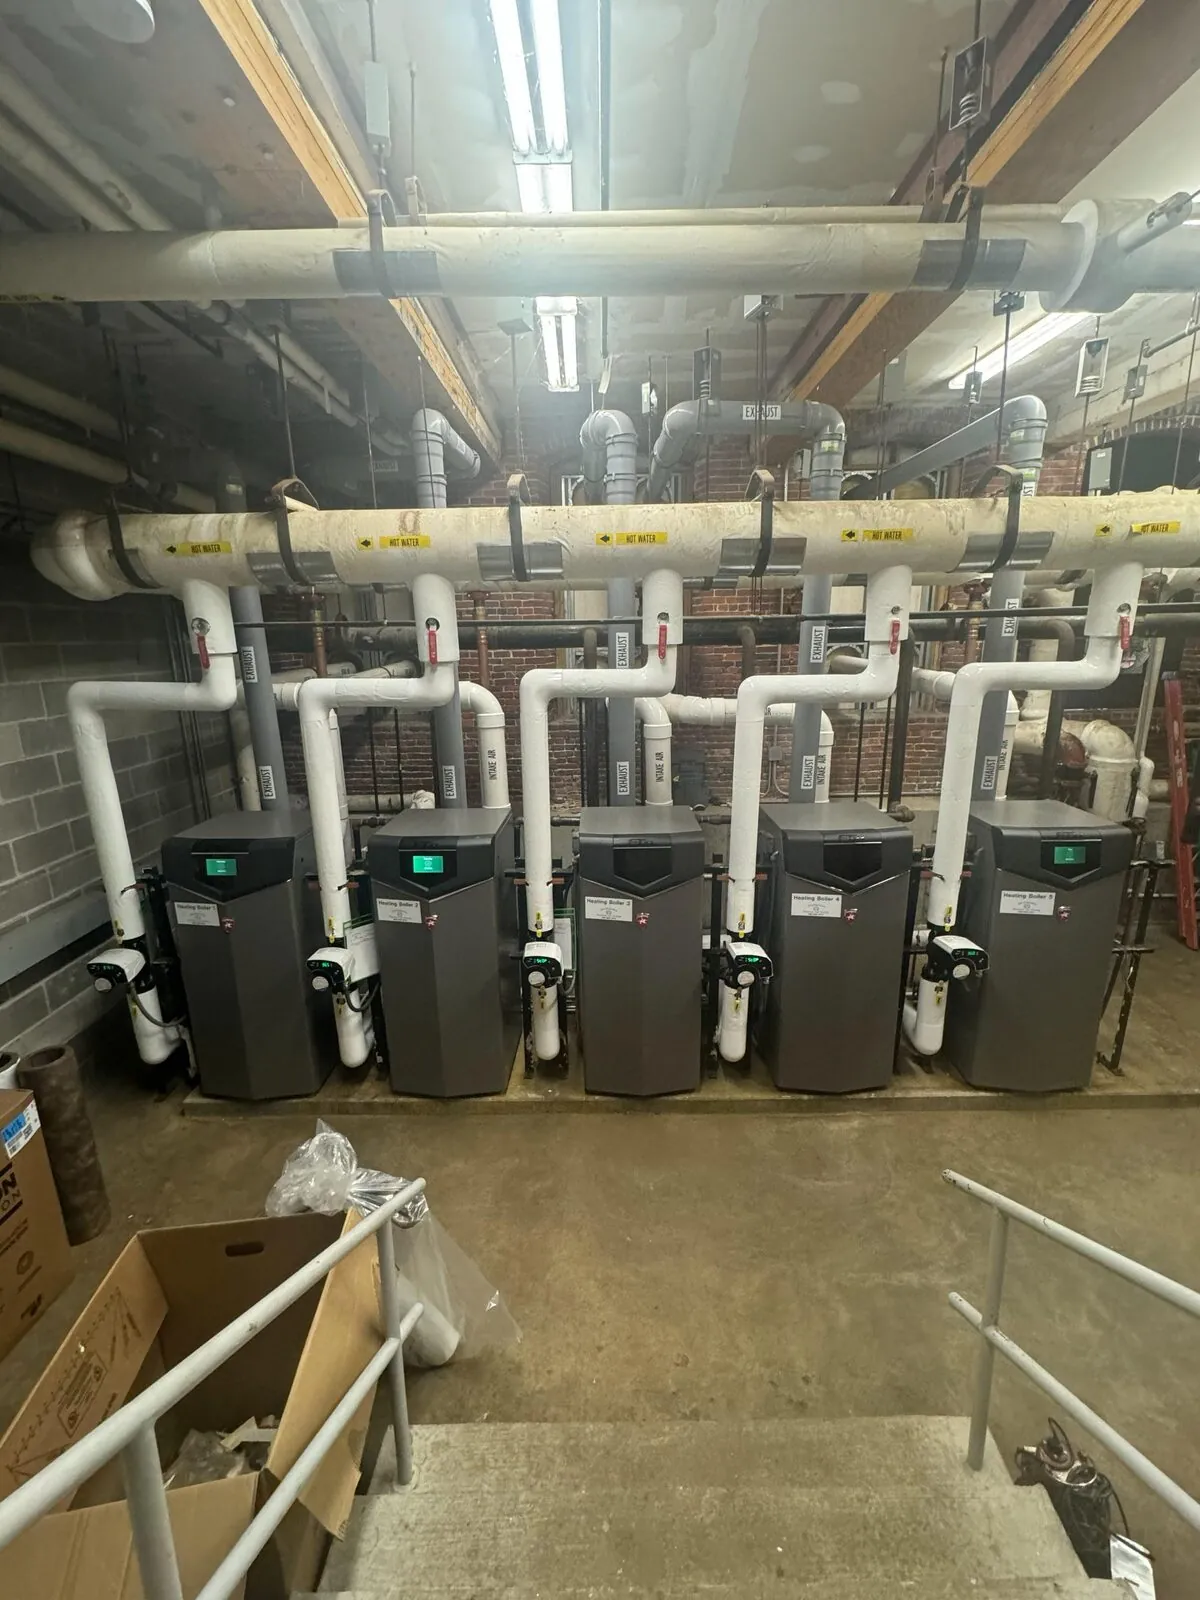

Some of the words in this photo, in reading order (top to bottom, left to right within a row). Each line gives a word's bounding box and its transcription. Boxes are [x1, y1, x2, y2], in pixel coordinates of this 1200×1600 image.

[871, 531, 882, 541] HOT
[883, 531, 903, 541] WATER
[1150, 523, 1169, 533] WATER
[191, 545, 202, 554] HOT
[203, 544, 221, 553] WATER
[389, 538, 400, 547] HOT
[401, 538, 420, 547] WATER
[626, 535, 636, 544] HOT
[638, 534, 656, 544] WATER
[1004, 601, 1018, 635] EXHST
[618, 635, 628, 667] EXHAUST
[812, 628, 824, 661] EXHAUST
[242, 649, 256, 681] EXHAUST
[487, 749, 496, 760] AIR
[655, 751, 663, 762] AIR
[489, 760, 497, 781] INTAKE
[619, 764, 628, 793] EXHAUST
[656, 763, 664, 783] INTAKE
[803, 758, 814, 788] EXHAUST
[983, 758, 997, 788] EXHAUST
[260, 768, 274, 798] EXHAUST
[444, 768, 455, 797] EXHAUST
[586, 898, 607, 906] Heating
